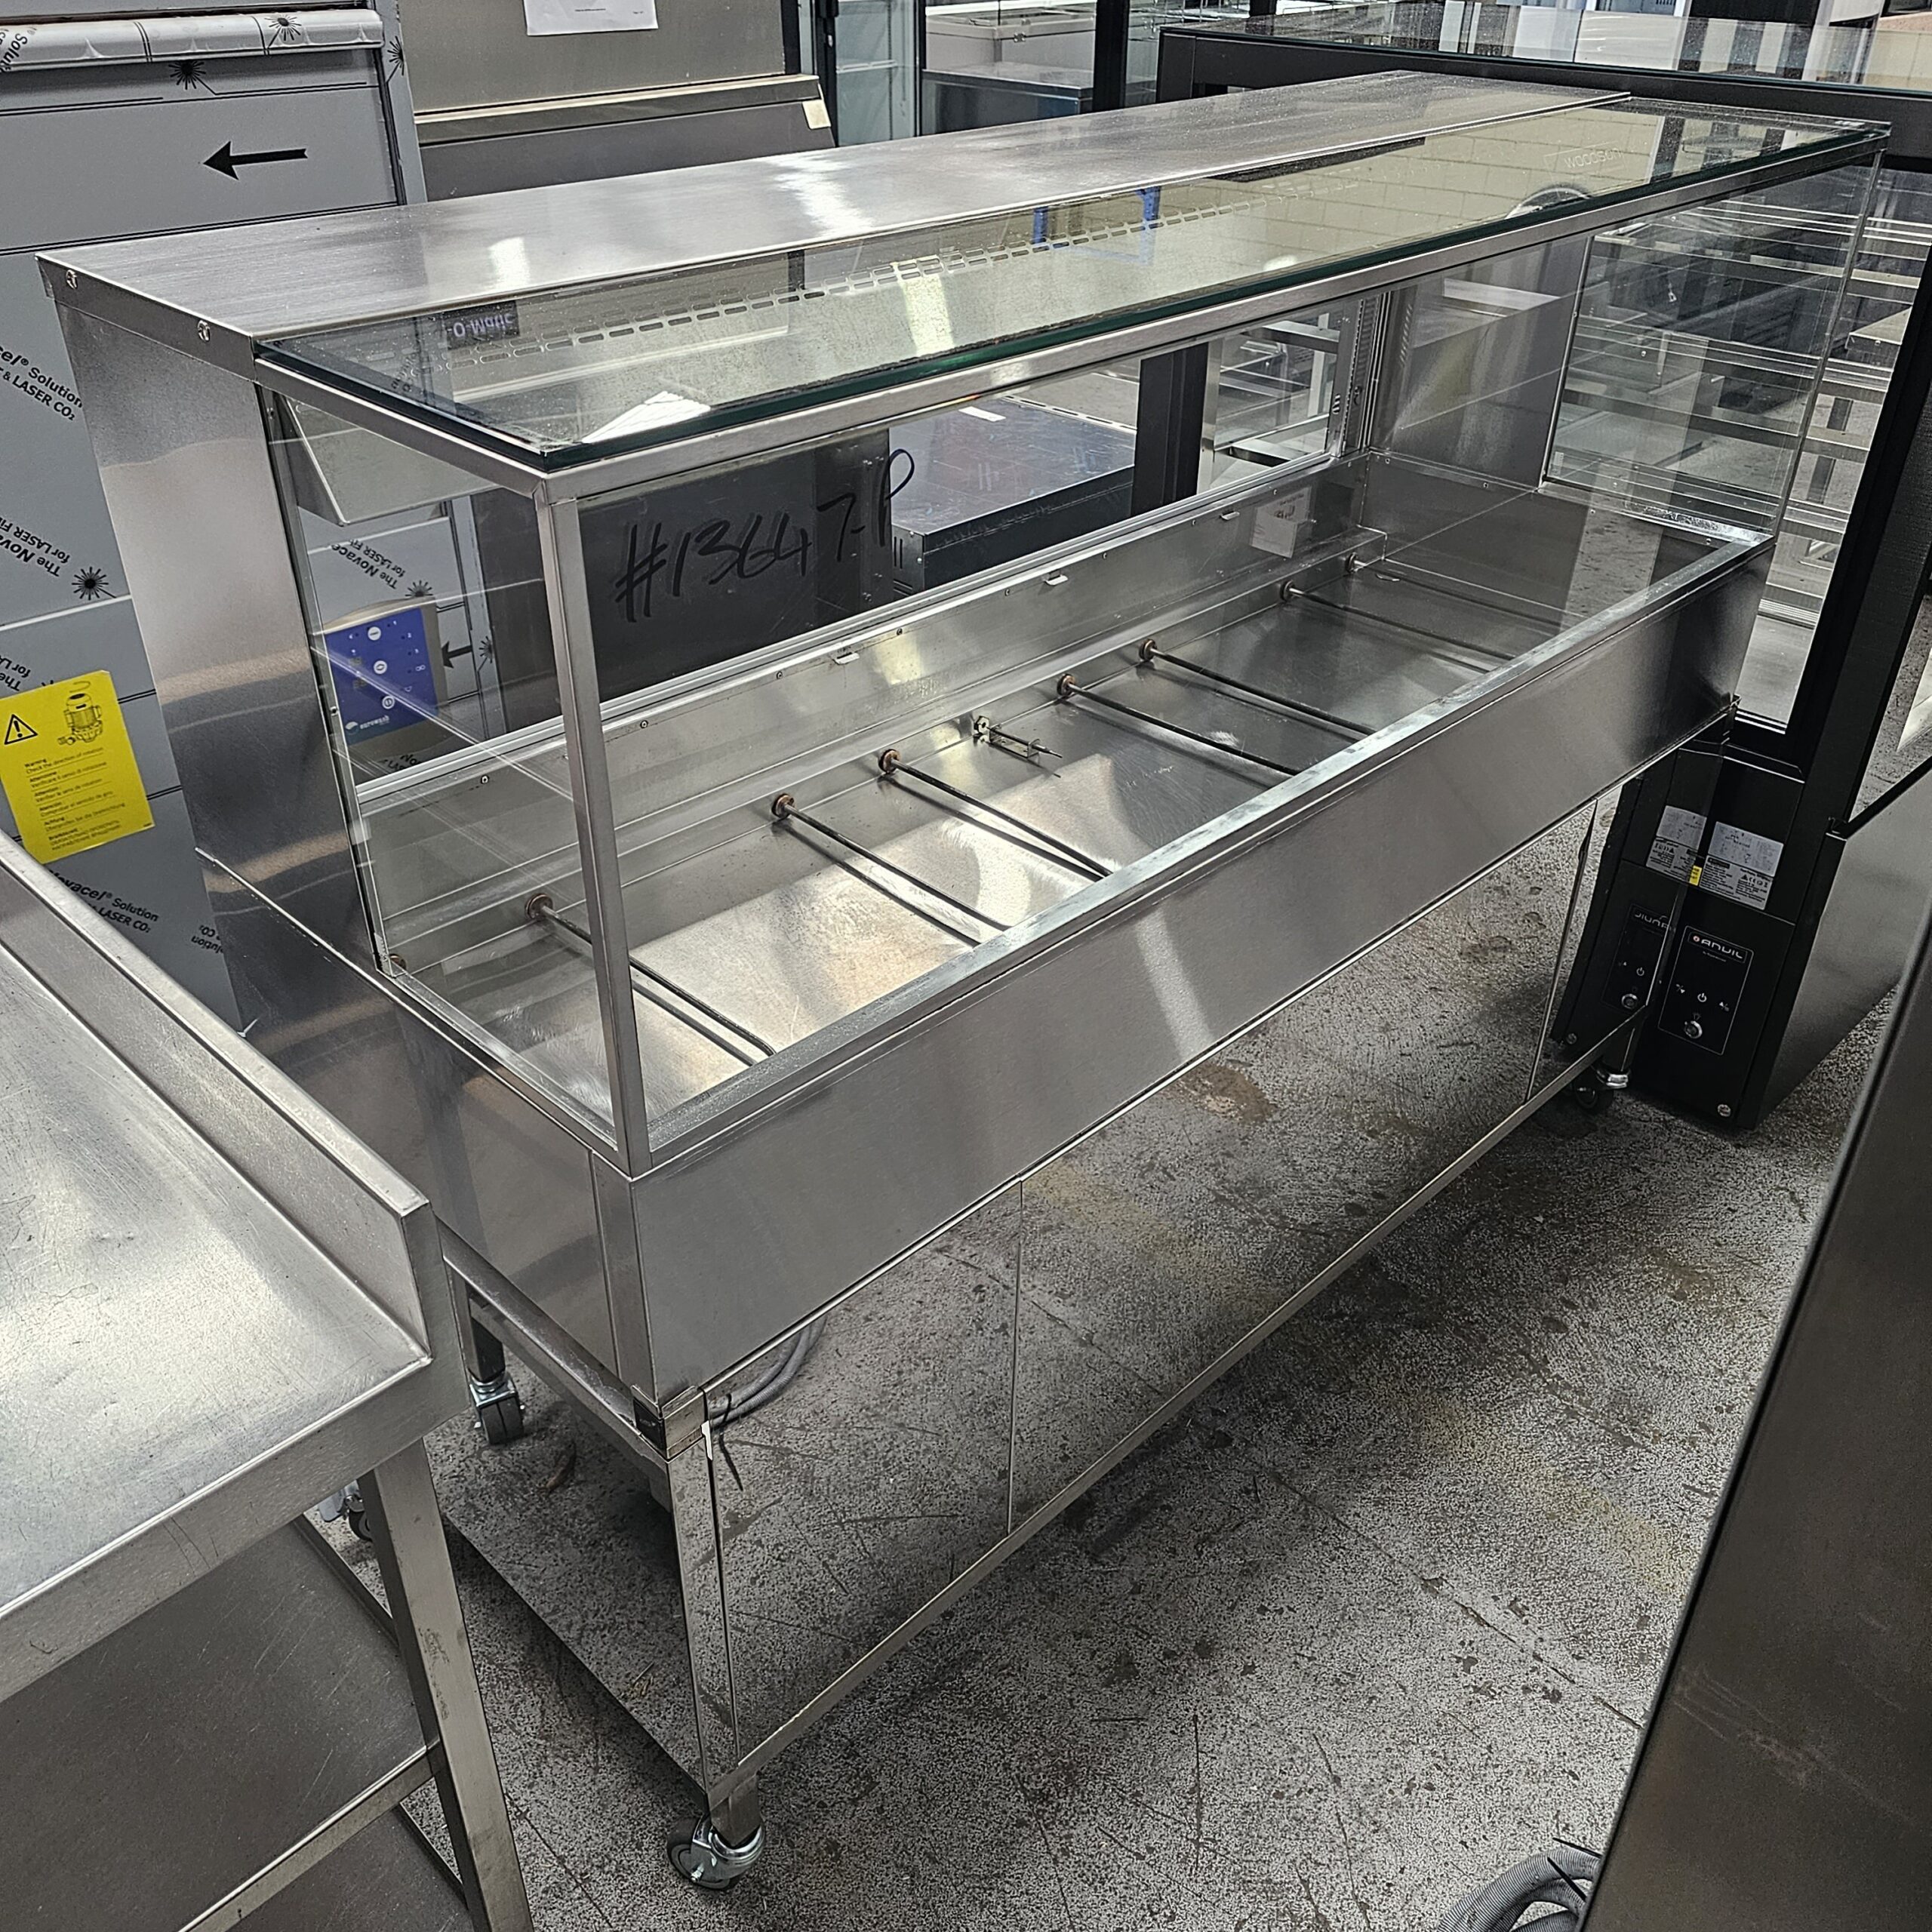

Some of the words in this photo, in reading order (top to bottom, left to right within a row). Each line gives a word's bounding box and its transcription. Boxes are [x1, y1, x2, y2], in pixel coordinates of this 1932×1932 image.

[12, 375, 53, 407] LASER
[28, 368, 82, 408] Solution
[13, 526, 53, 554] LASER
[51, 549, 70, 564] for
[36, 557, 60, 577] The
[380, 571, 398, 589] The
[11, 664, 31, 678] for
[112, 898, 158, 922] Solution
[1701, 939, 1743, 959] ANVIL
